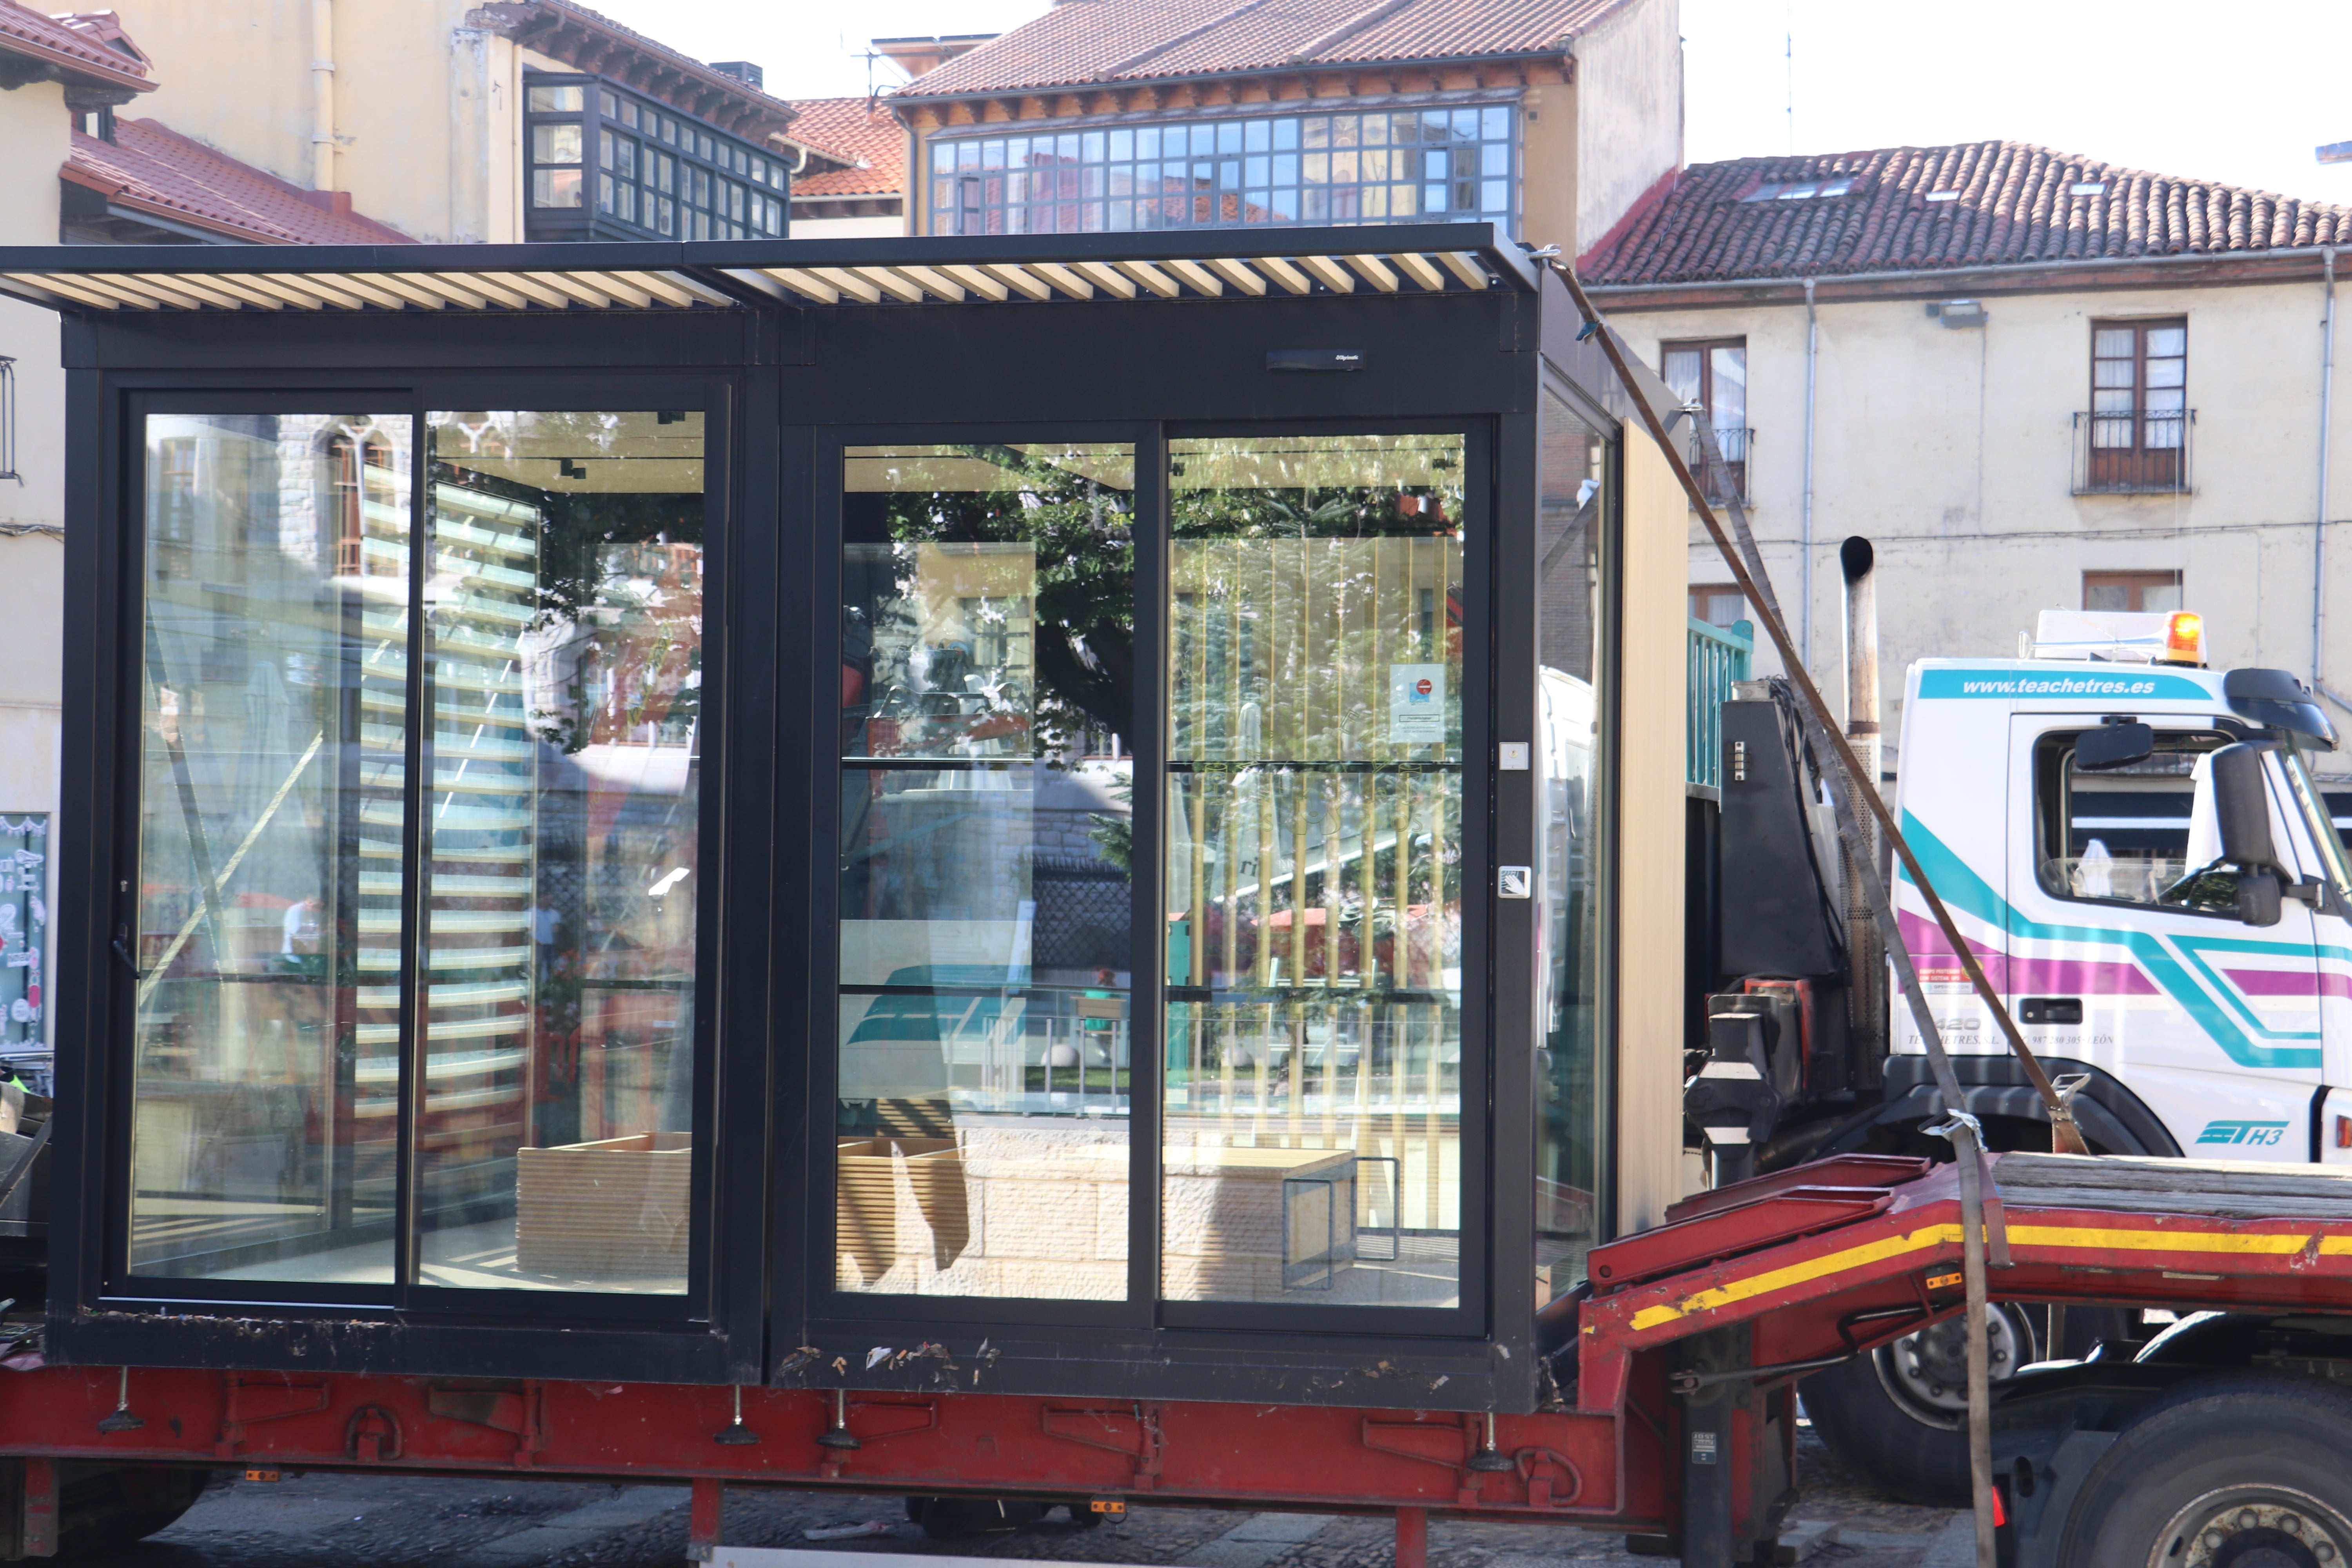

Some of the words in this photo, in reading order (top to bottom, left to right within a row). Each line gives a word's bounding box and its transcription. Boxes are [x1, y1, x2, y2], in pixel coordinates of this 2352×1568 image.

[1963, 678, 2155, 693] www.teachetres.es
[1935, 1018, 1981, 1030] 420
[1982, 1035, 1999, 1044] S.L.
[2032, 1036, 2046, 1044] 987
[2049, 1036, 2063, 1044] 280
[2087, 1034, 2114, 1044] LEÓN
